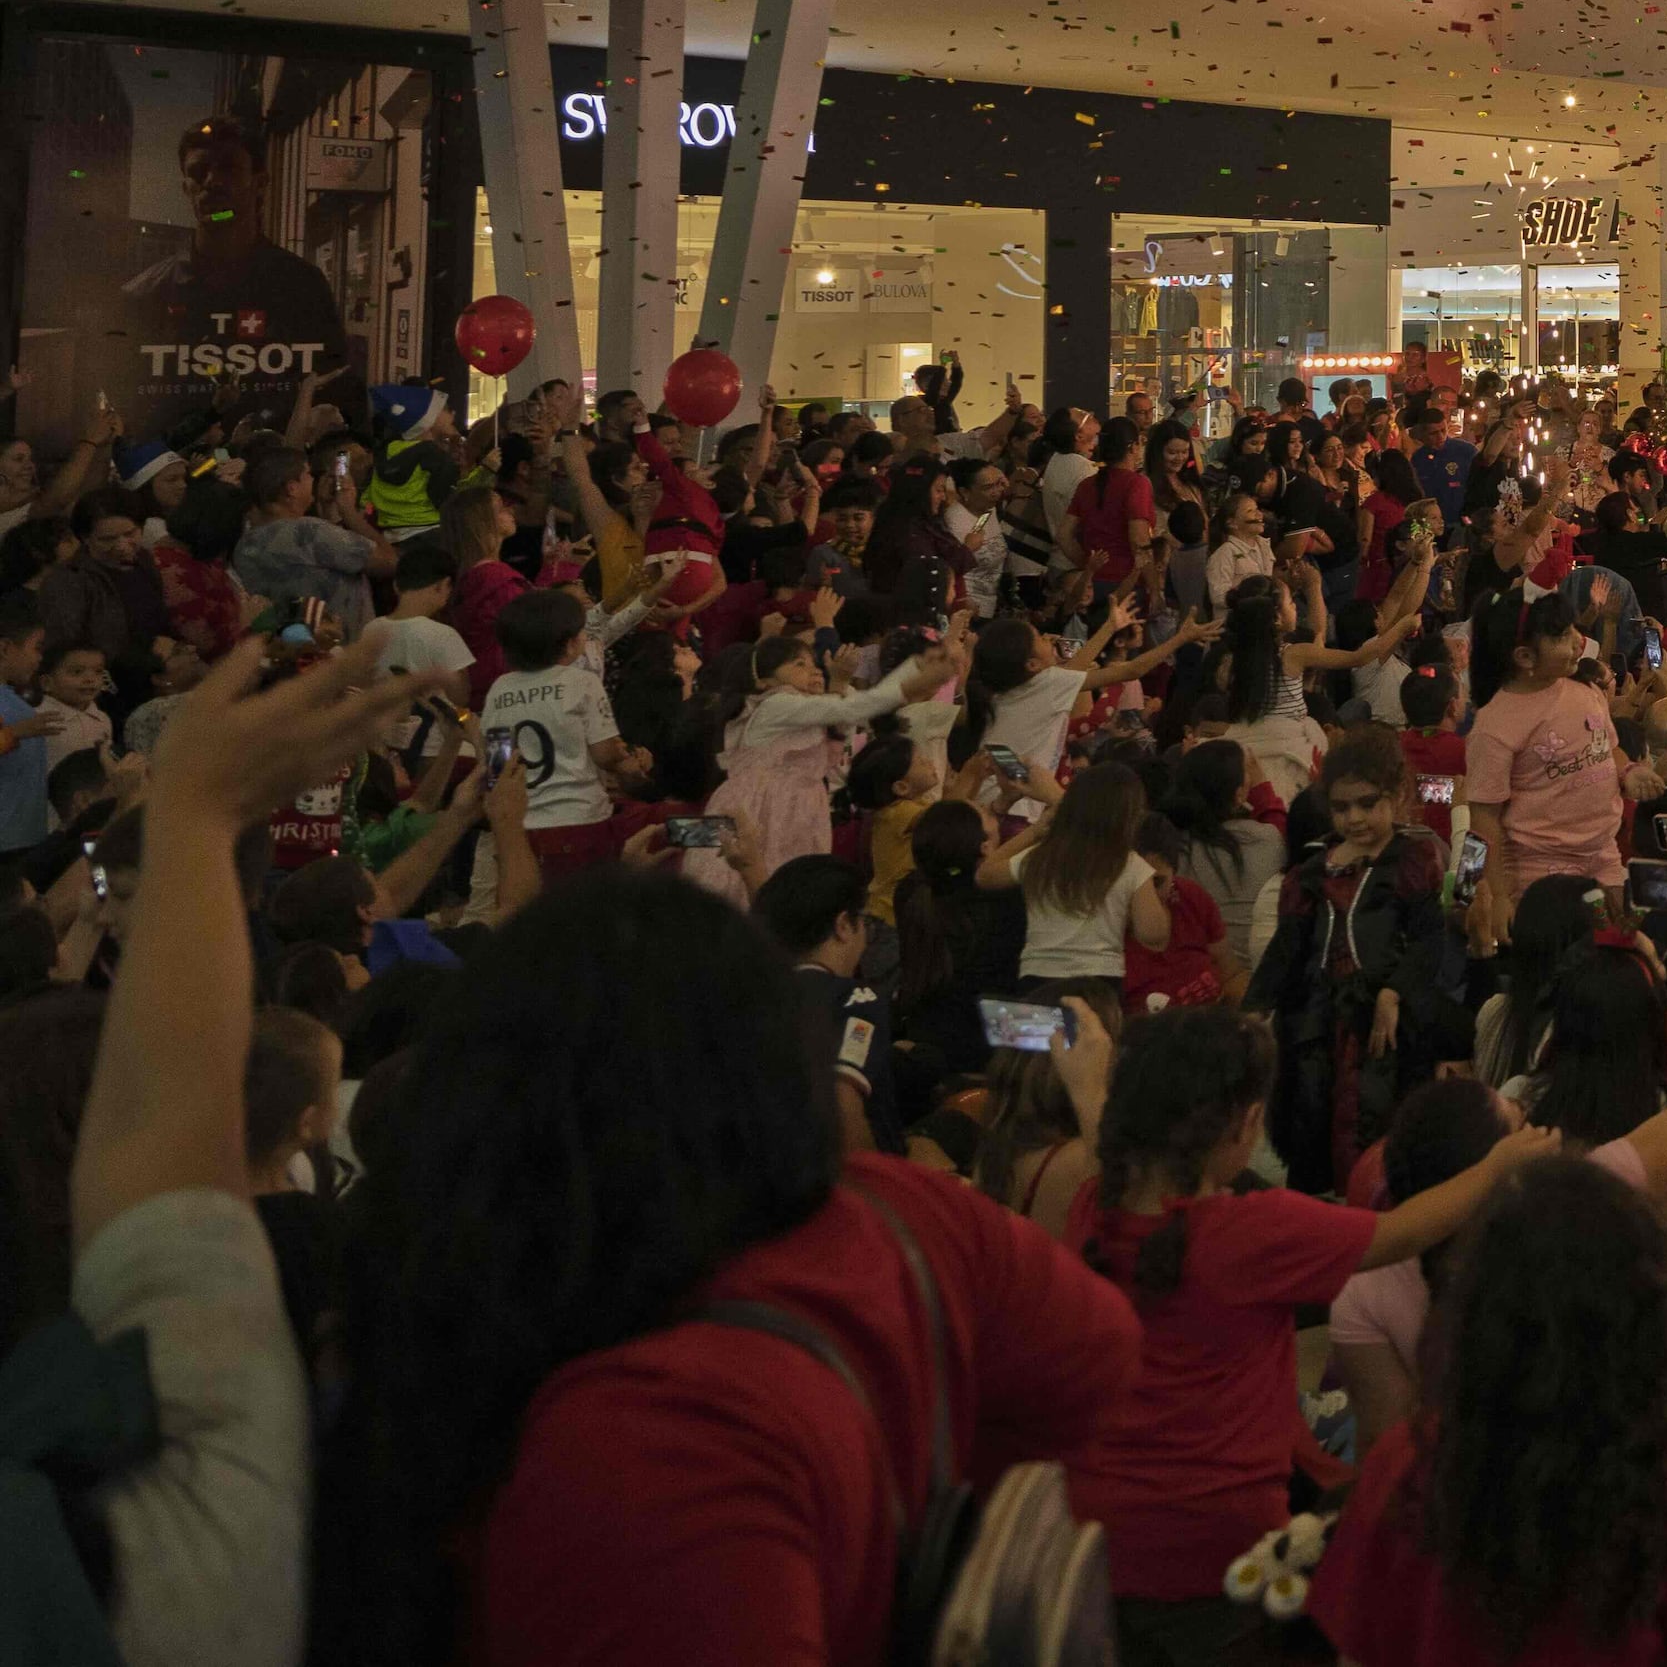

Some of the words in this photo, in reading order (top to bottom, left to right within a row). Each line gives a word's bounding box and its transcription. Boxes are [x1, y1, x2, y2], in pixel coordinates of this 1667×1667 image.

[1522, 199, 1602, 246] SHOE
[802, 291, 853, 302] TISSOT
[874, 284, 928, 299] BULOVA
[140, 342, 325, 377] TISSOT
[514, 719, 555, 789] 9
